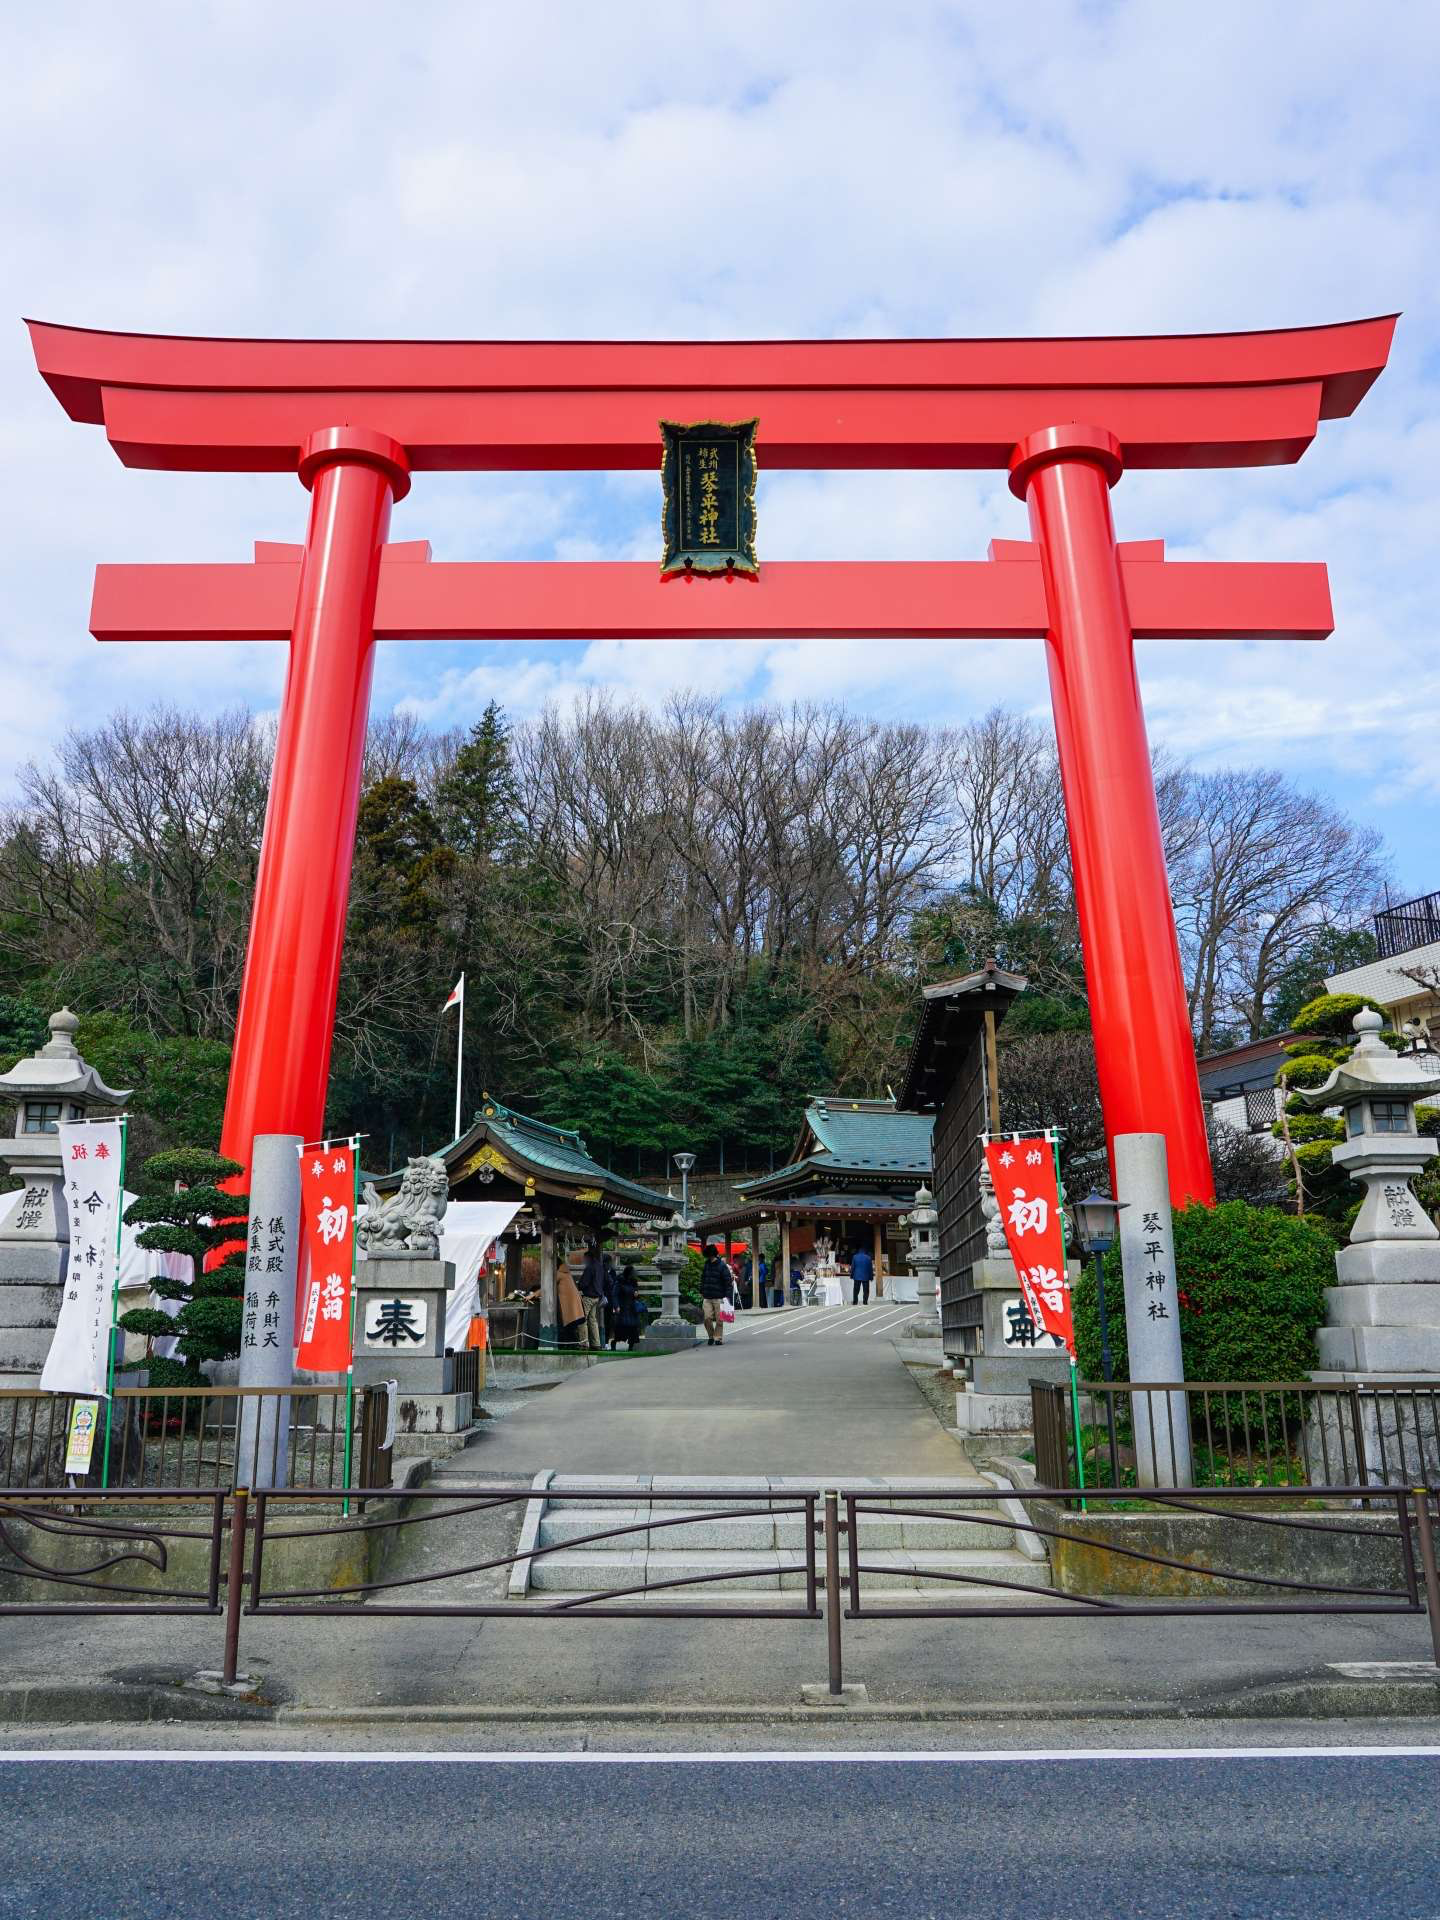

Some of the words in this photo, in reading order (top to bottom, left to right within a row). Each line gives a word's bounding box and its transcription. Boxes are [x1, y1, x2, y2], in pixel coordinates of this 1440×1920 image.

[699, 471, 720, 544] 琴平神社
[311, 1156, 347, 1178] 奉納
[997, 1148, 1042, 1169] 奉納
[249, 1216, 263, 1272] 参集殿
[265, 1216, 286, 1273] 儀式殿
[317, 1195, 348, 1321] 初詣
[1007, 1187, 1065, 1314] 初詣
[1142, 1212, 1169, 1321] 琴平神社
[244, 1291, 259, 1349] 稲荷社
[262, 1290, 281, 1349] 弁財天
[366, 1299, 425, 1347] 奉
